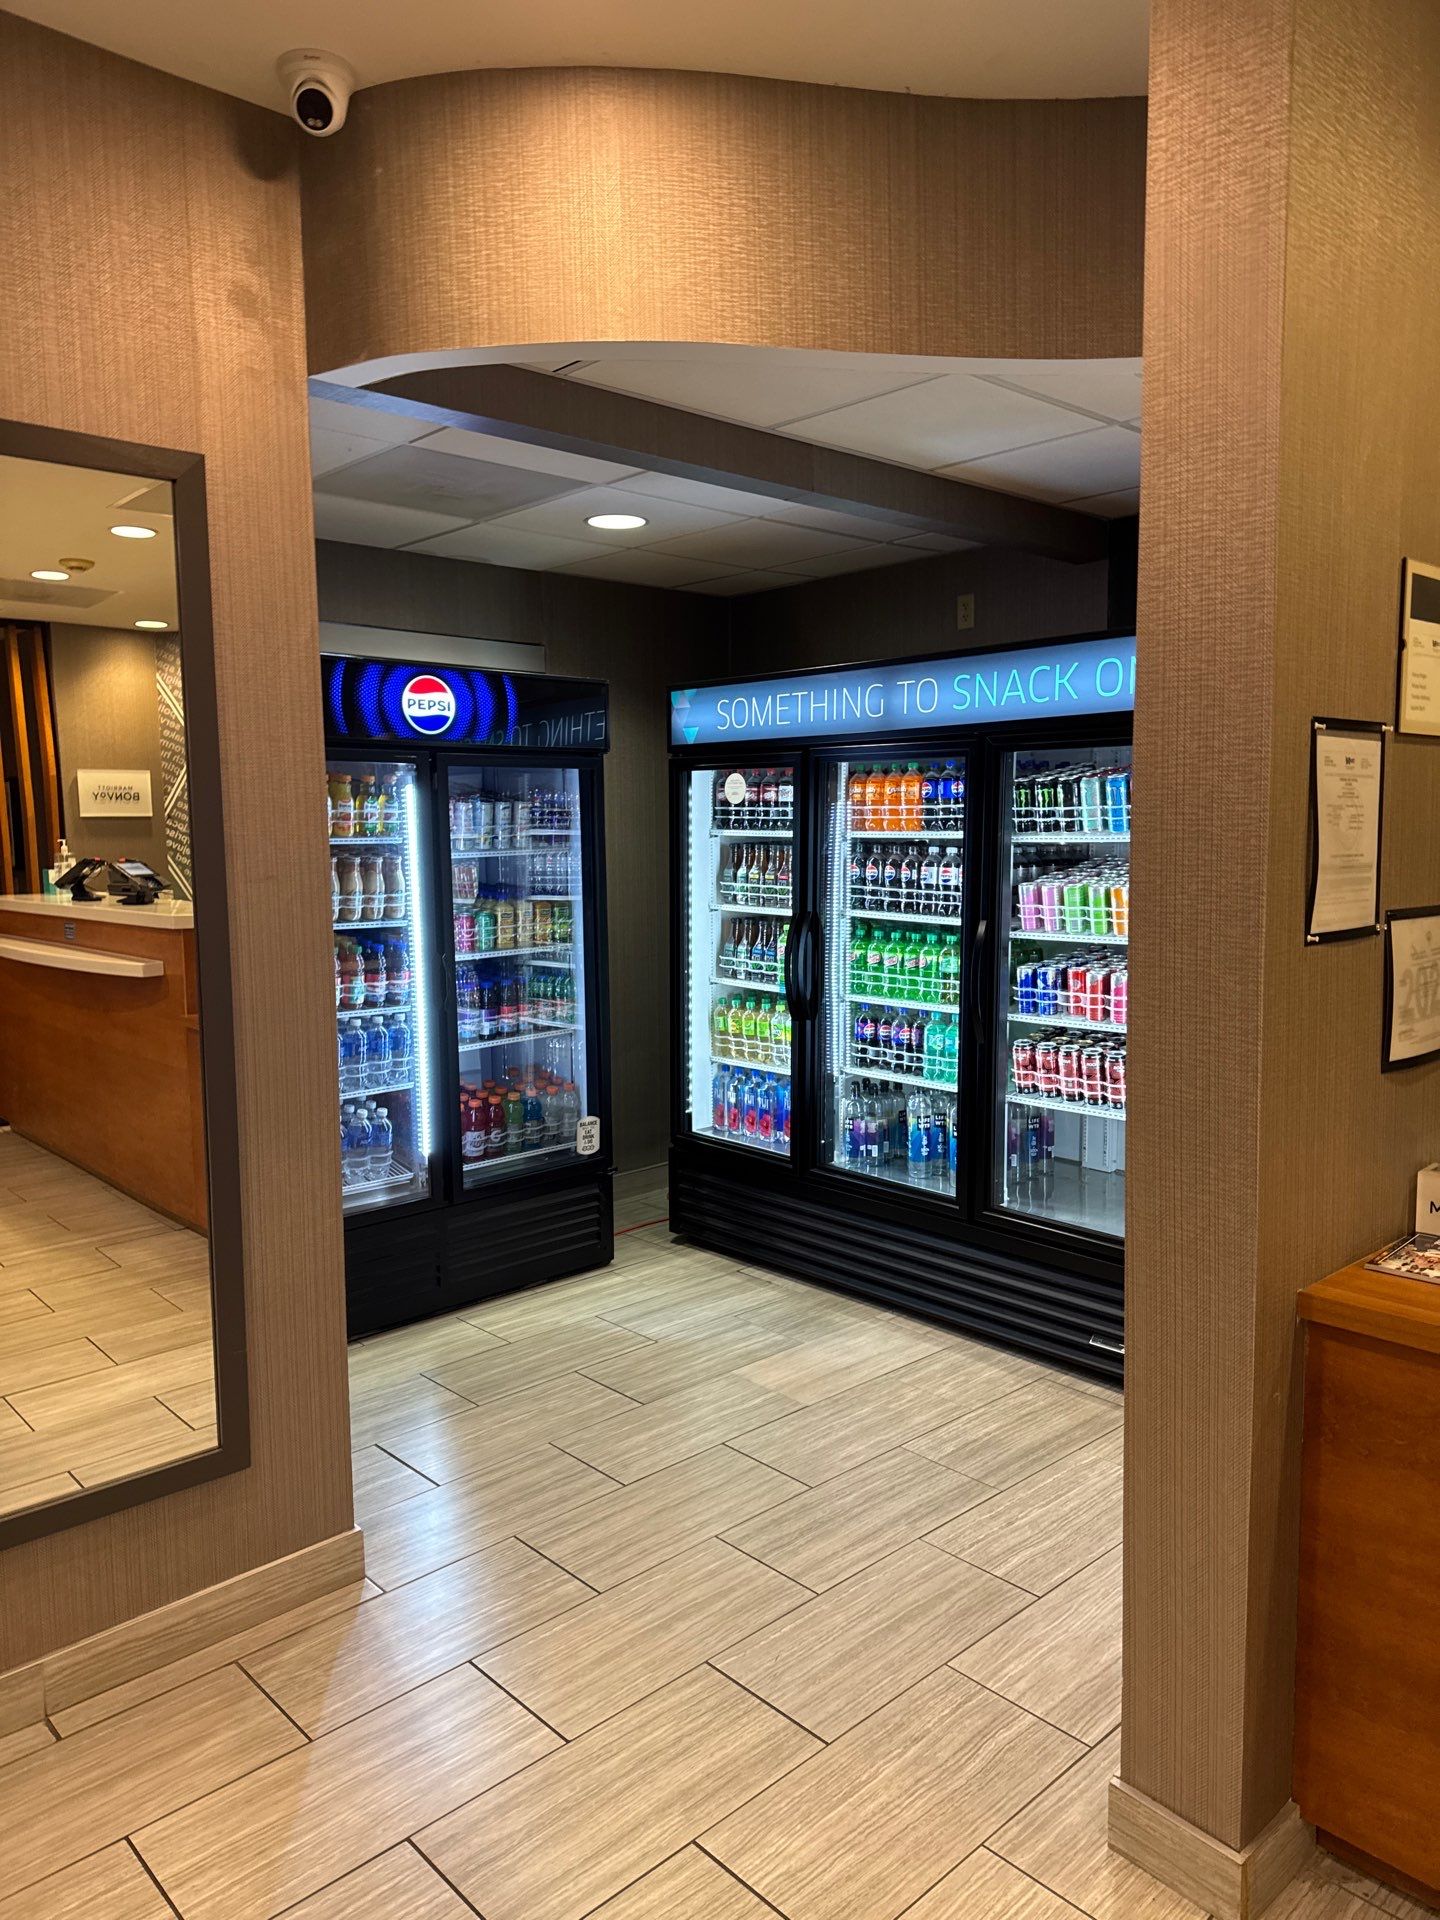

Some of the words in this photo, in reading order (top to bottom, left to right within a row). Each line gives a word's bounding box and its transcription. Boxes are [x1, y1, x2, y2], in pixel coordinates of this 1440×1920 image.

[407, 698, 451, 712] PEPSI
[717, 683, 885, 731] SOMETHING
[897, 677, 939, 715] TO
[952, 661, 1080, 711] SNACK
